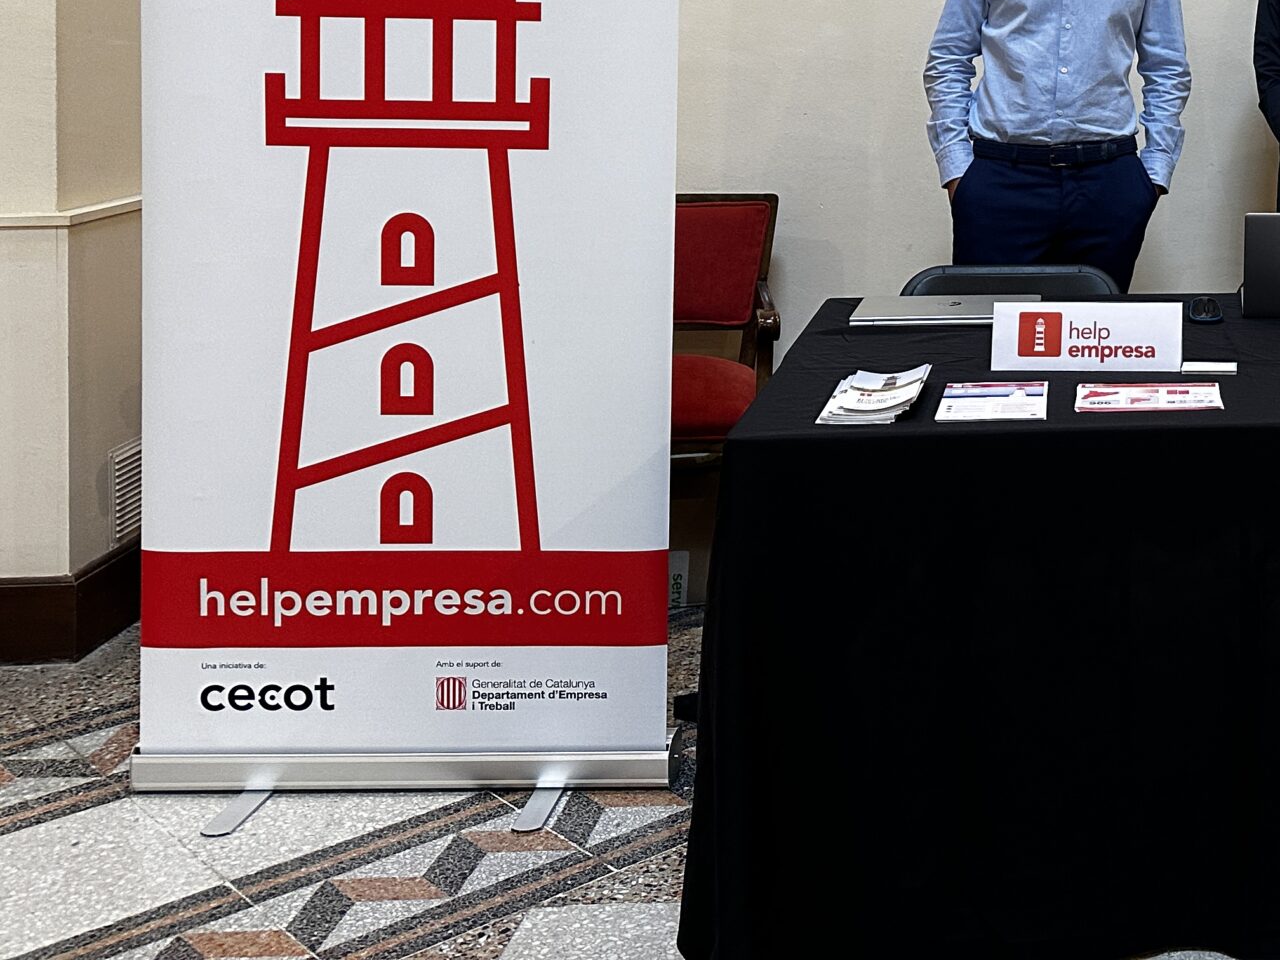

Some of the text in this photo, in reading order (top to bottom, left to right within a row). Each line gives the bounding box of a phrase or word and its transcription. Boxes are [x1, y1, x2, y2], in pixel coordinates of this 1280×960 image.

[1069, 320, 1111, 346] help
[1068, 345, 1156, 363] empresa
[200, 577, 623, 627] helpempresa.com
[219, 661, 252, 669] iniciativa
[436, 660, 454, 668] Amb
[456, 659, 464, 668] el
[465, 660, 489, 670] suport
[471, 678, 596, 690] Generalitat de Catalunya
[200, 676, 336, 712] cecot
[471, 690, 608, 701] Departament d'Empresa
[471, 701, 516, 711] i Treball
